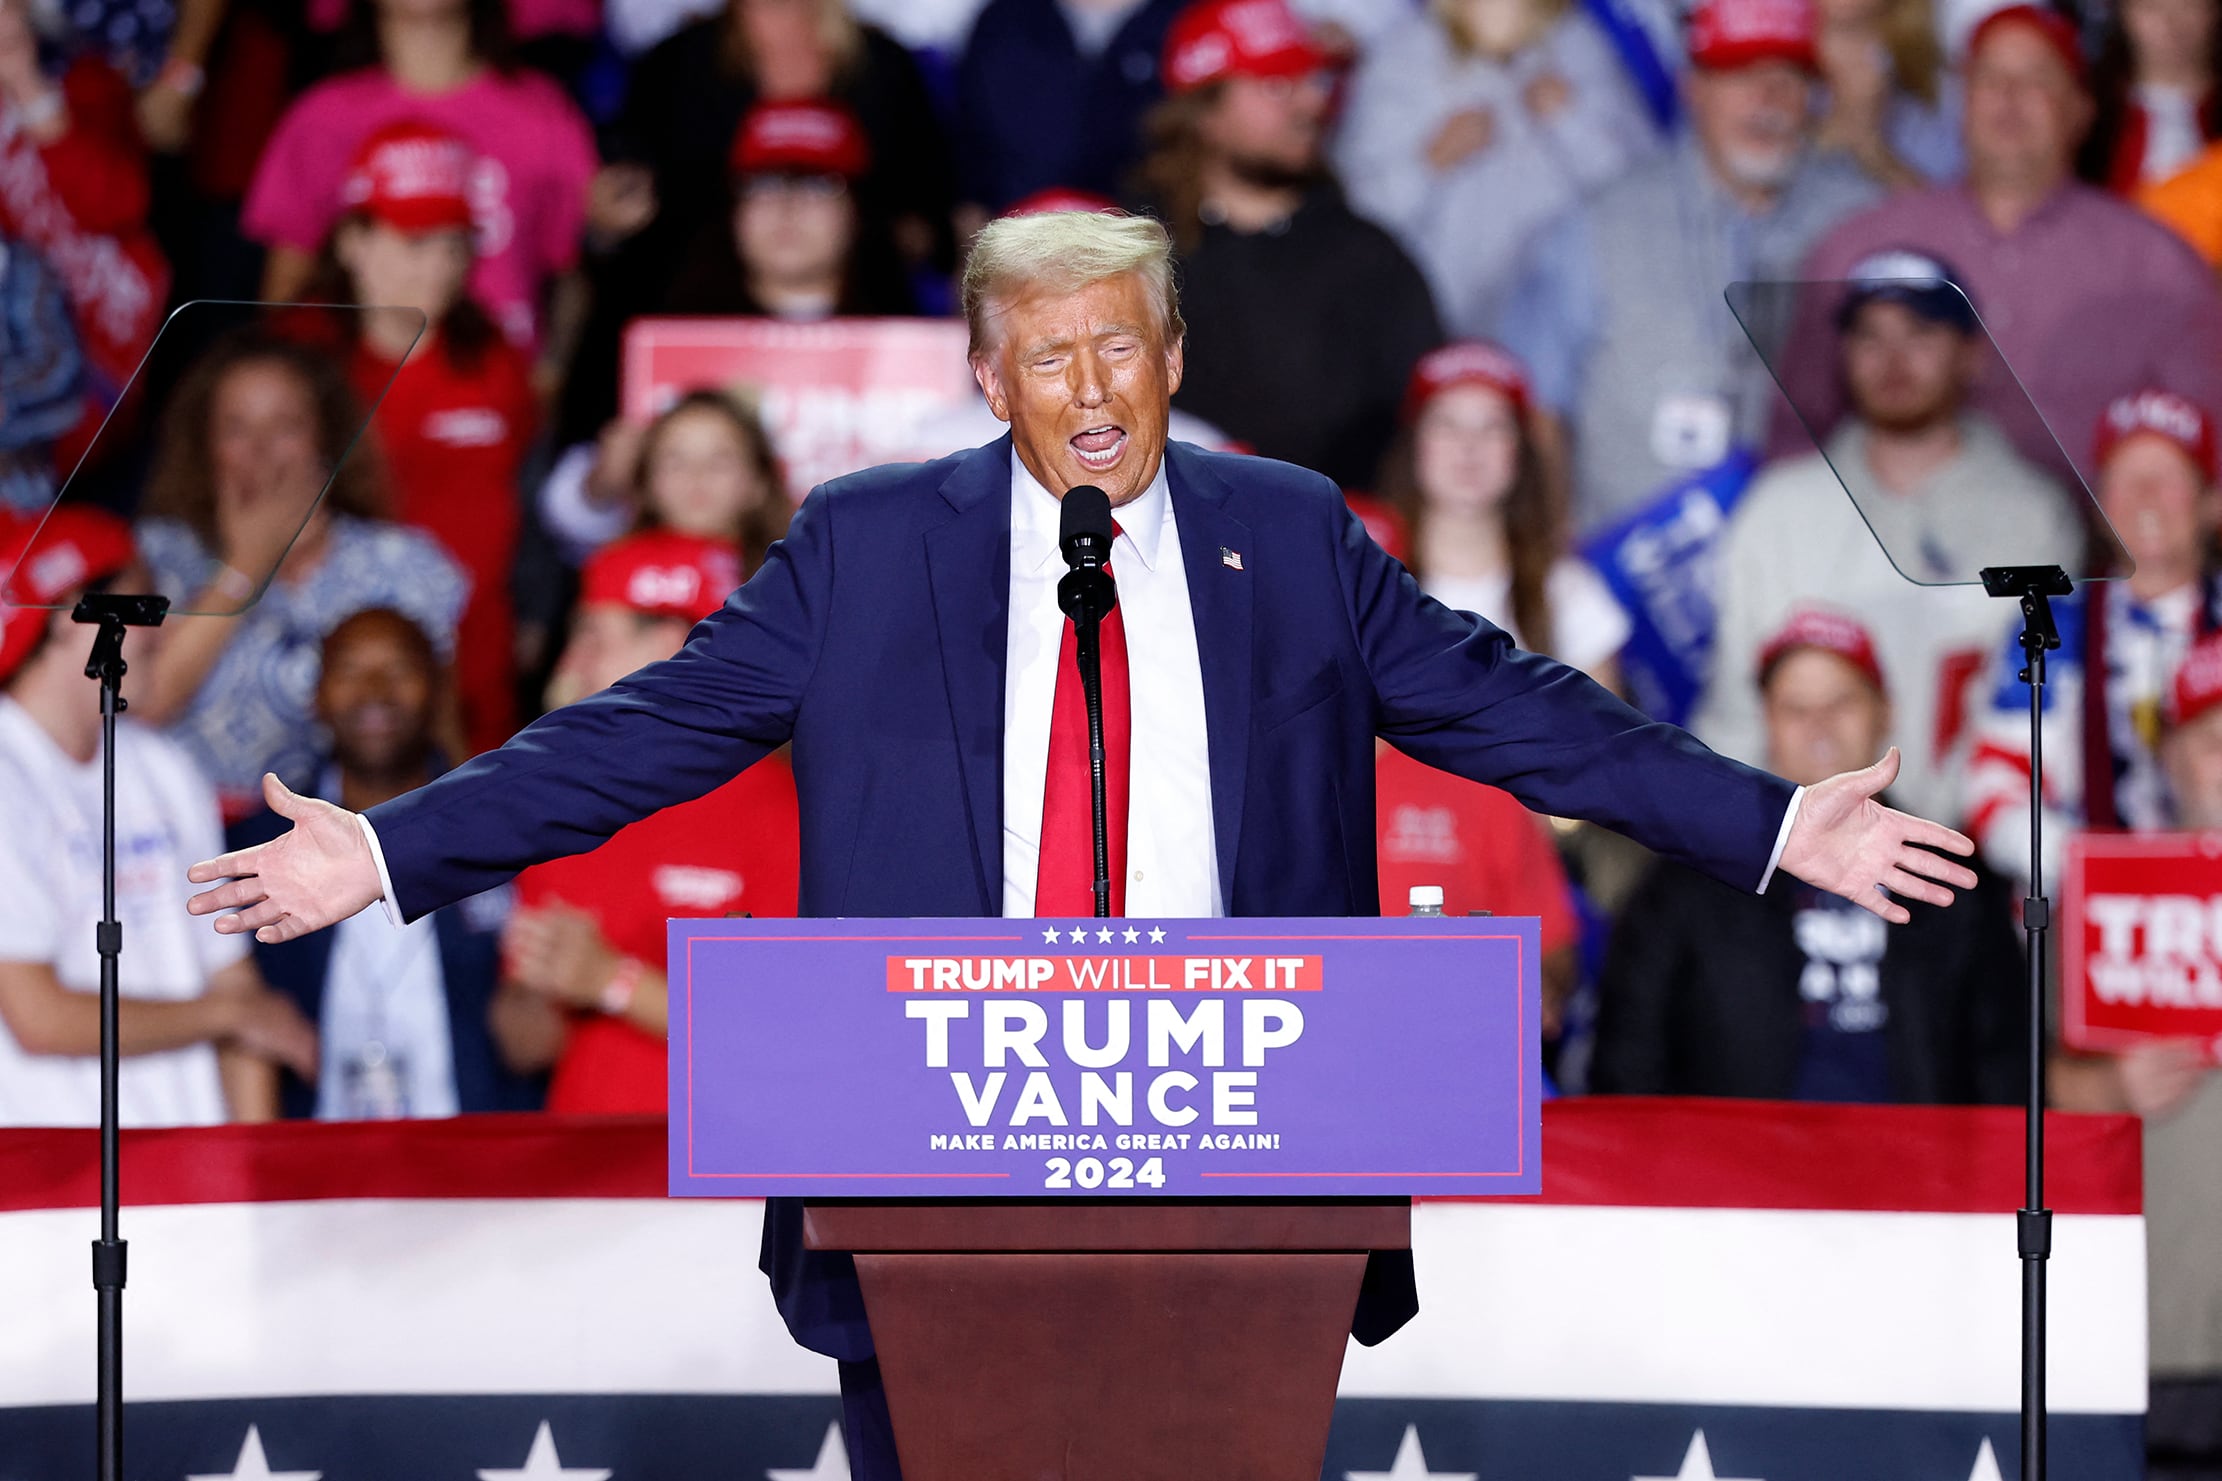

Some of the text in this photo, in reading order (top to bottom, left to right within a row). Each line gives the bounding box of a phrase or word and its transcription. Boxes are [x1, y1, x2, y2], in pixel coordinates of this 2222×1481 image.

[2087, 893, 2222, 960] TR
[905, 958, 1304, 990] TRUMP WILL FIX IT
[905, 999, 1306, 1068] TRUMP
[950, 1070, 1258, 1127] VANCE
[930, 1133, 1280, 1150] MAKE AMERICA GREAT AGAIN!
[1044, 1157, 1166, 1189] 2024
